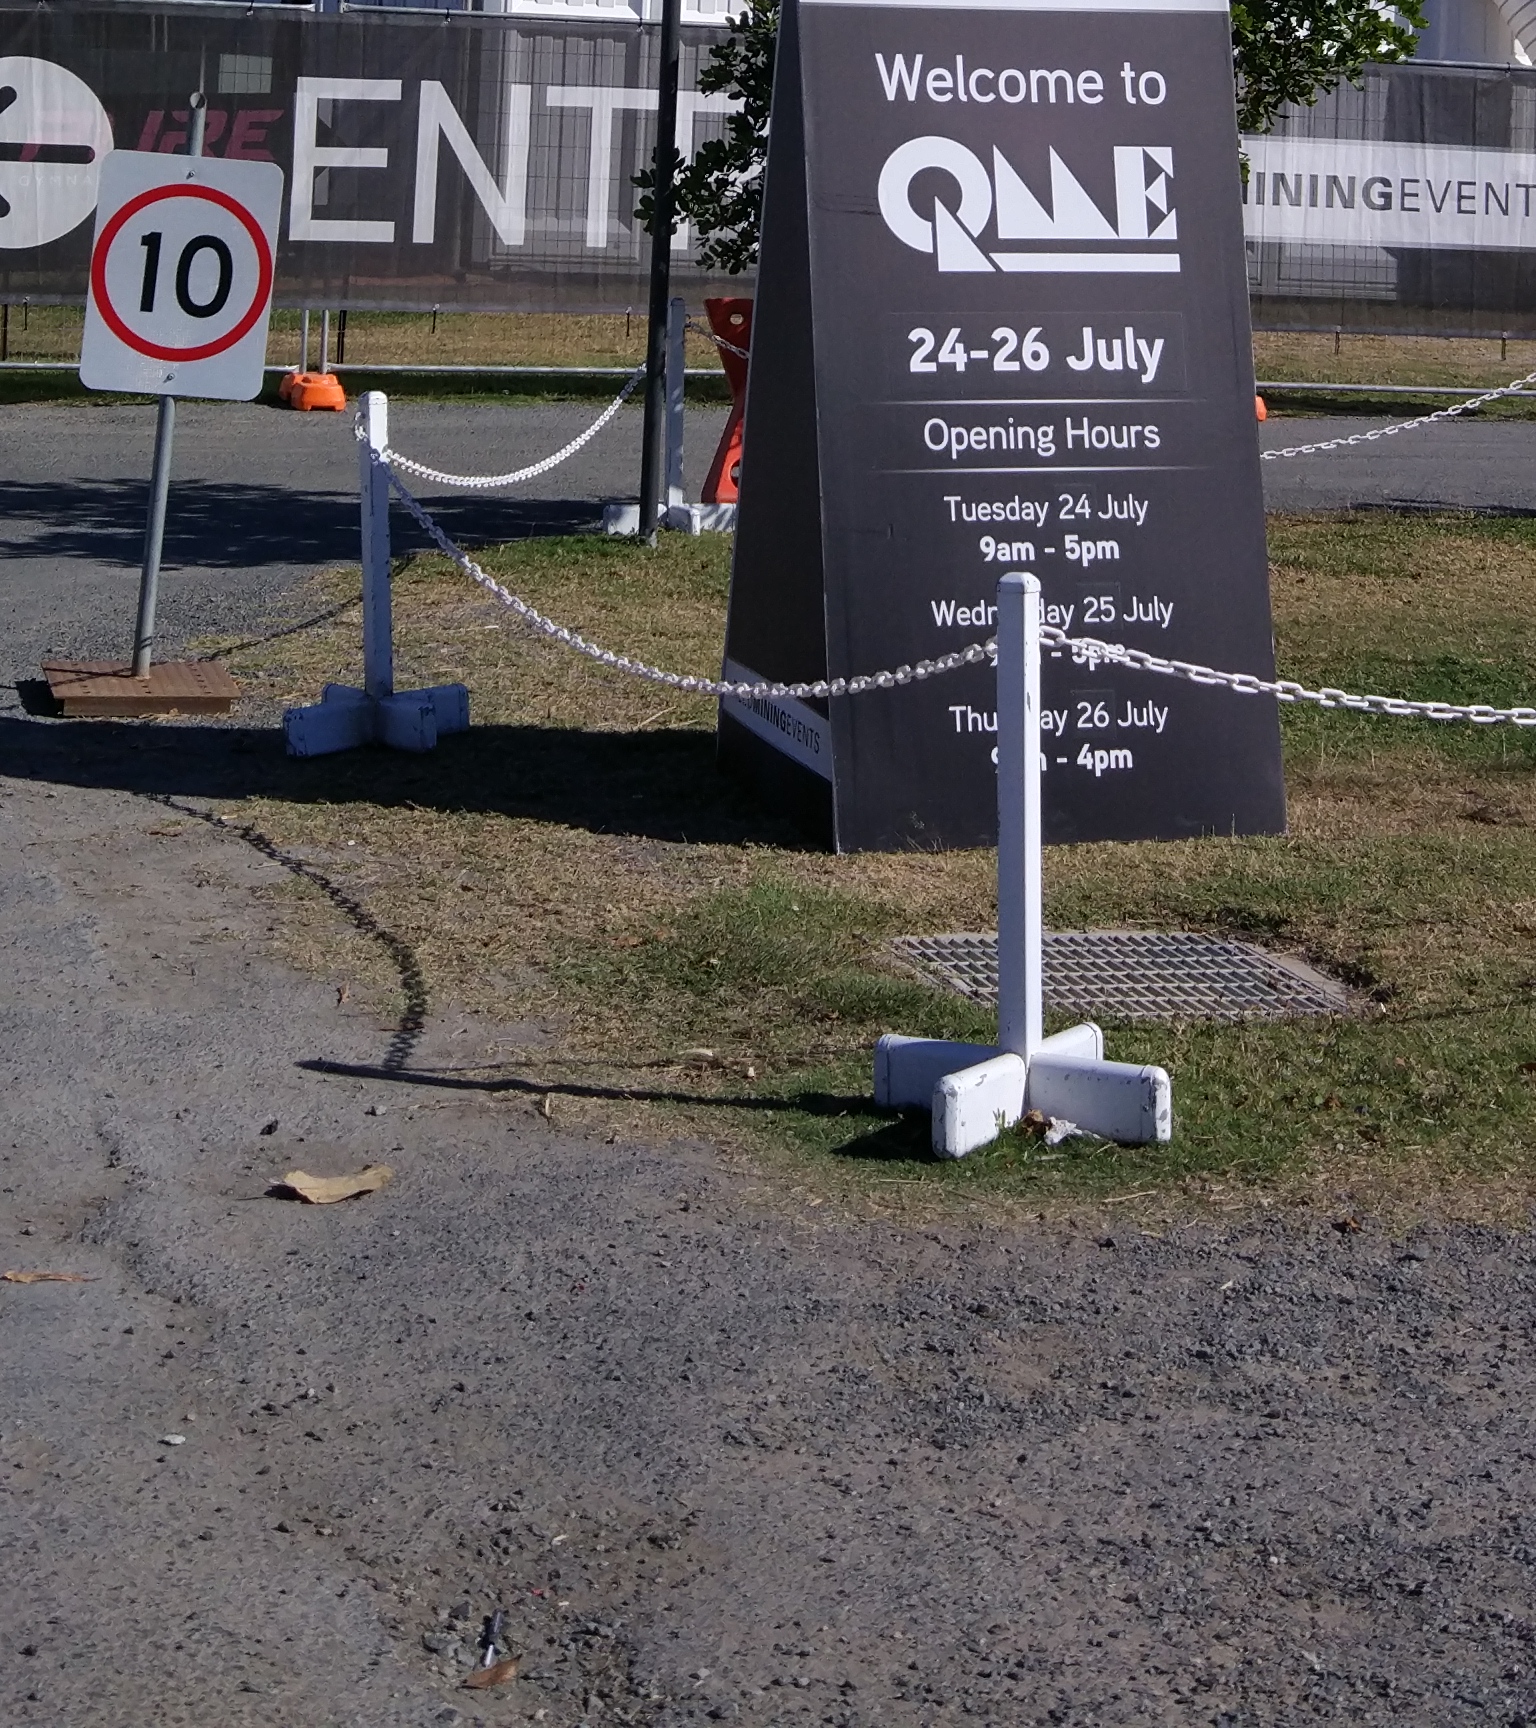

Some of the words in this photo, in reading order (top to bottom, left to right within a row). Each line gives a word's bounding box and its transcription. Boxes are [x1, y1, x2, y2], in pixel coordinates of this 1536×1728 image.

[875, 53, 1104, 104] Welcome
[1121, 61, 1167, 106] to
[877, 135, 1181, 273] QME
[139, 230, 234, 320] 10
[907, 326, 1050, 372] 24-26
[1065, 326, 1165, 384] July
[924, 417, 1056, 459] Opening
[1066, 416, 1161, 449] Hours
[943, 494, 1049, 528] Tuesday
[1058, 493, 1091, 519] 24
[1097, 493, 1149, 526] July
[979, 535, 1036, 562] 9am
[1063, 534, 1120, 567] 5pm
[931, 598, 1074, 631] Weday
[1083, 596, 1116, 623] 25
[1122, 595, 1174, 628] July
[948, 704, 1068, 737] Thuay
[1076, 701, 1110, 728] 26
[1117, 699, 1169, 734] July
[1076, 743, 1133, 777] 4pm
